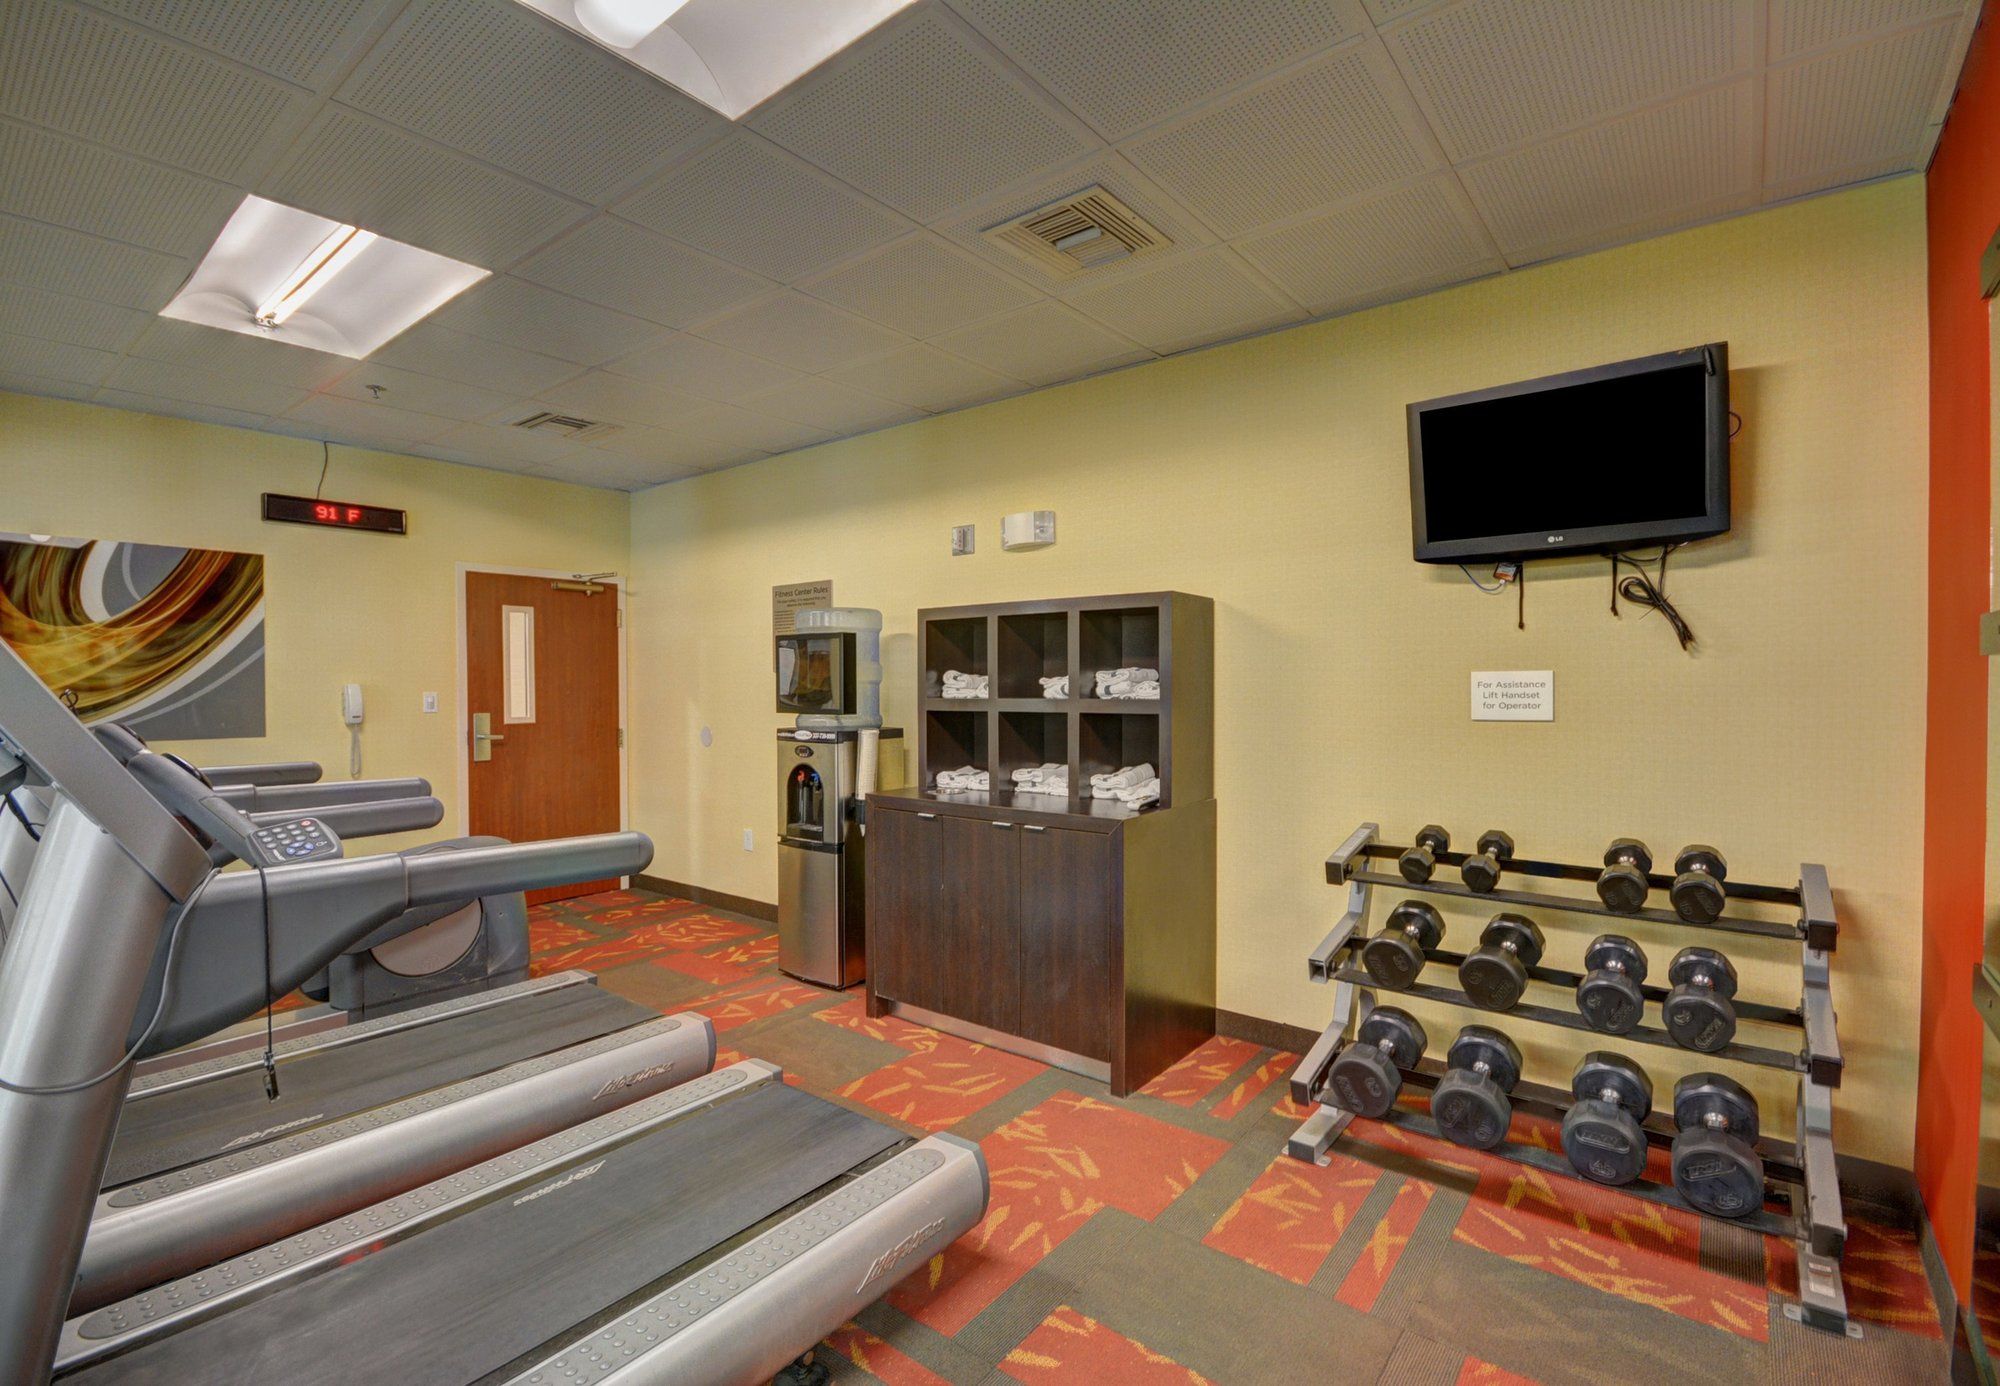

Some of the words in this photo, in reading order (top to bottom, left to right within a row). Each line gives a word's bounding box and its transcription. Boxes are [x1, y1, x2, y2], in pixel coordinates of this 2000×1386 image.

[315, 505, 338, 520] 91
[347, 509, 361, 522] F
[774, 590, 793, 598] Fitness
[794, 588, 812, 596] Center
[813, 586, 829, 594] Rules
[1477, 681, 1492, 689] For
[1495, 681, 1546, 689] Assistance
[1482, 691, 1498, 699] Lift
[1501, 691, 1540, 699] Handset
[1482, 701, 1495, 709] for
[1498, 701, 1541, 711] Operator
